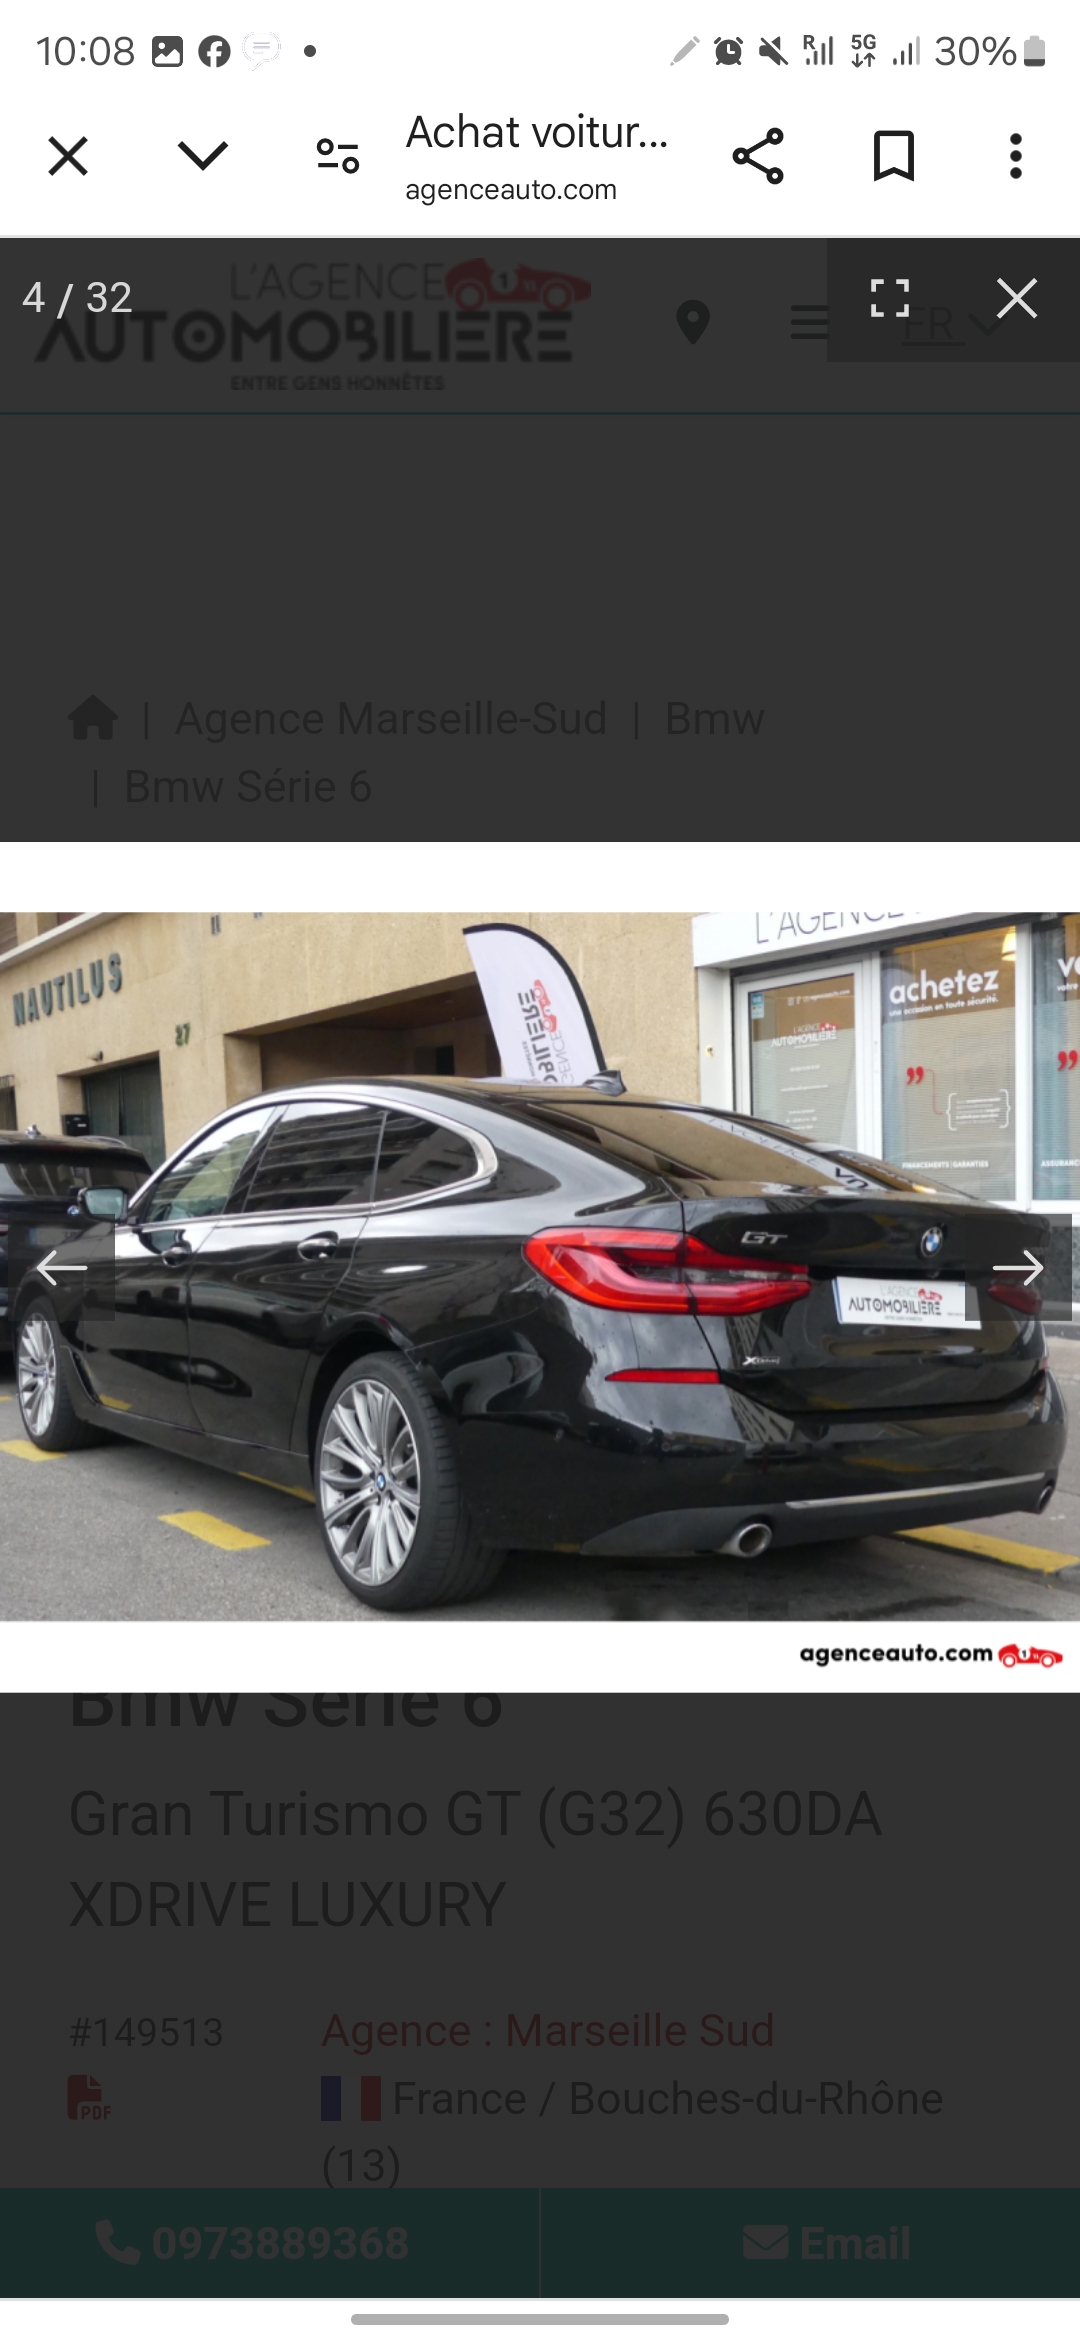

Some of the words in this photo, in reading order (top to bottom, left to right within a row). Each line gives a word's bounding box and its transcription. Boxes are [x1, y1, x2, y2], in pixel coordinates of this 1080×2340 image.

[37, 37, 134, 65] 10:08
[851, 34, 876, 50] 5G
[935, 37, 1016, 65] 30%
[406, 113, 519, 148] Achat
[532, 113, 666, 148] voitur...
[406, 180, 616, 205] agenceauto.com
[230, 263, 445, 300] L'AGENCE
[23, 282, 45, 312] 4
[57, 284, 73, 319] /
[86, 282, 132, 312] 32
[905, 307, 954, 339] FR
[231, 376, 287, 391] ENTRE
[293, 376, 342, 391] GENS
[347, 371, 445, 391] HONNÊTES
[175, 702, 323, 743] Agence
[340, 701, 605, 734] Marseille-Sud
[668, 702, 764, 734] Bmw
[127, 771, 224, 802] Bmw
[238, 768, 335, 802] Série
[351, 771, 371, 802] 6
[756, 912, 904, 943] L'AGE
[13, 953, 122, 1026] NAUTILUS
[890, 969, 999, 1004] achetez
[904, 1004, 933, 1015] occasion
[945, 1000, 965, 1009] toute
[175, 1022, 191, 1046] 27
[902, 1161, 949, 1169] FINANCEMENTS
[953, 1159, 989, 1168] GARANTIES
[741, 1231, 788, 1244] GT
[73, 1694, 239, 1726] Bmw
[464, 1694, 502, 1727] 6
[71, 1790, 190, 1836] Gran
[210, 1791, 427, 1836] Turismo
[448, 1790, 521, 1836] GT
[540, 1786, 683, 1849] (G32)
[706, 1790, 882, 1836] 630DA
[70, 1882, 270, 1926] XDRIVE
[292, 1882, 506, 1926] LUXURY
[70, 2018, 222, 2046] #149513
[322, 2014, 470, 2055] Agence
[508, 2012, 686, 2046] Marseille
[700, 2012, 772, 2046] Sud
[82, 2106, 111, 2120] PDF
[395, 2082, 525, 2114] France
[572, 2080, 943, 2114] Bouches-du-Rhône
[324, 2145, 399, 2187] (13)
[153, 2227, 408, 2259] 0973889368
[801, 2226, 909, 2259] Email
